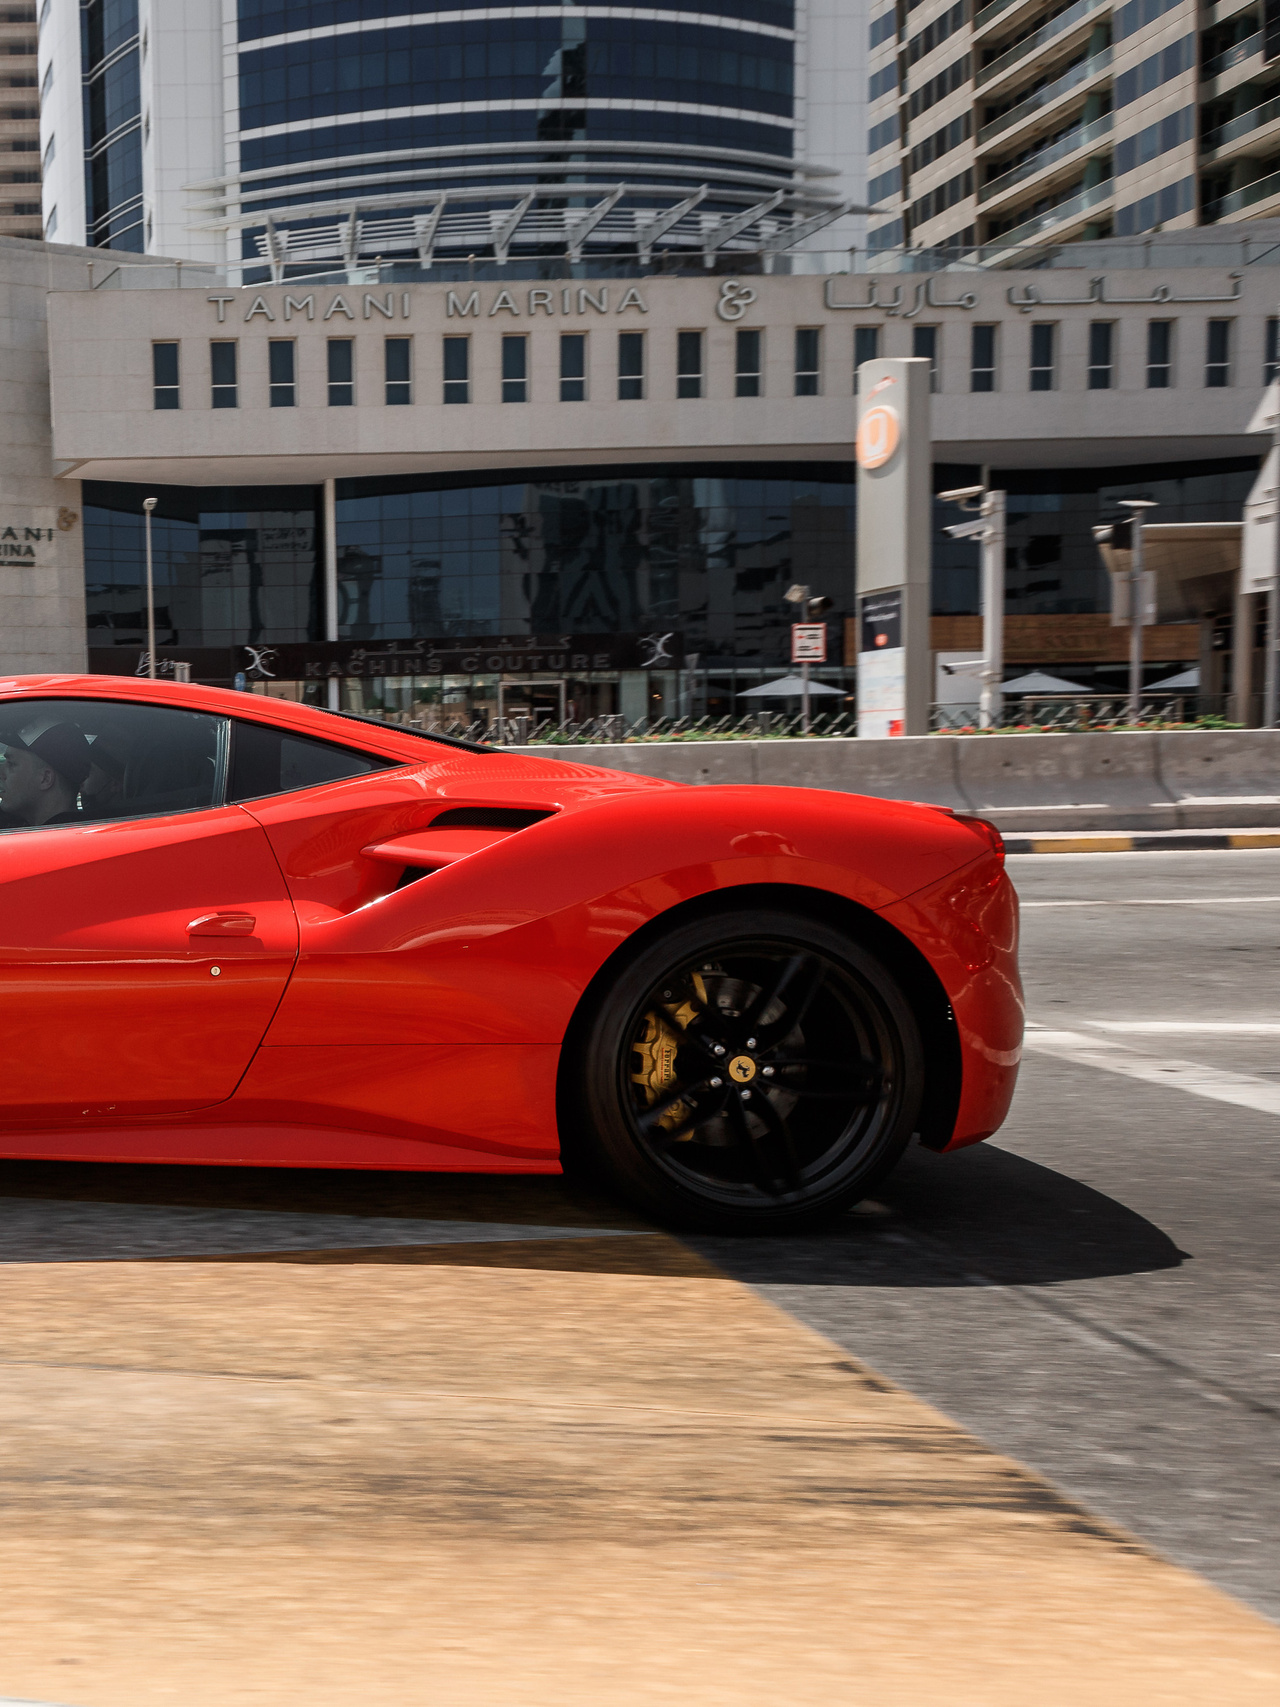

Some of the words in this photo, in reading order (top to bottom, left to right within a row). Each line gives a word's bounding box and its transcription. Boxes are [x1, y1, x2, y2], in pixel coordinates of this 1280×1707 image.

[208, 291, 411, 323] TAMANI
[446, 285, 650, 318] MARINA
[305, 657, 443, 677] KACHINS
[460, 653, 611, 672] COUTURE
